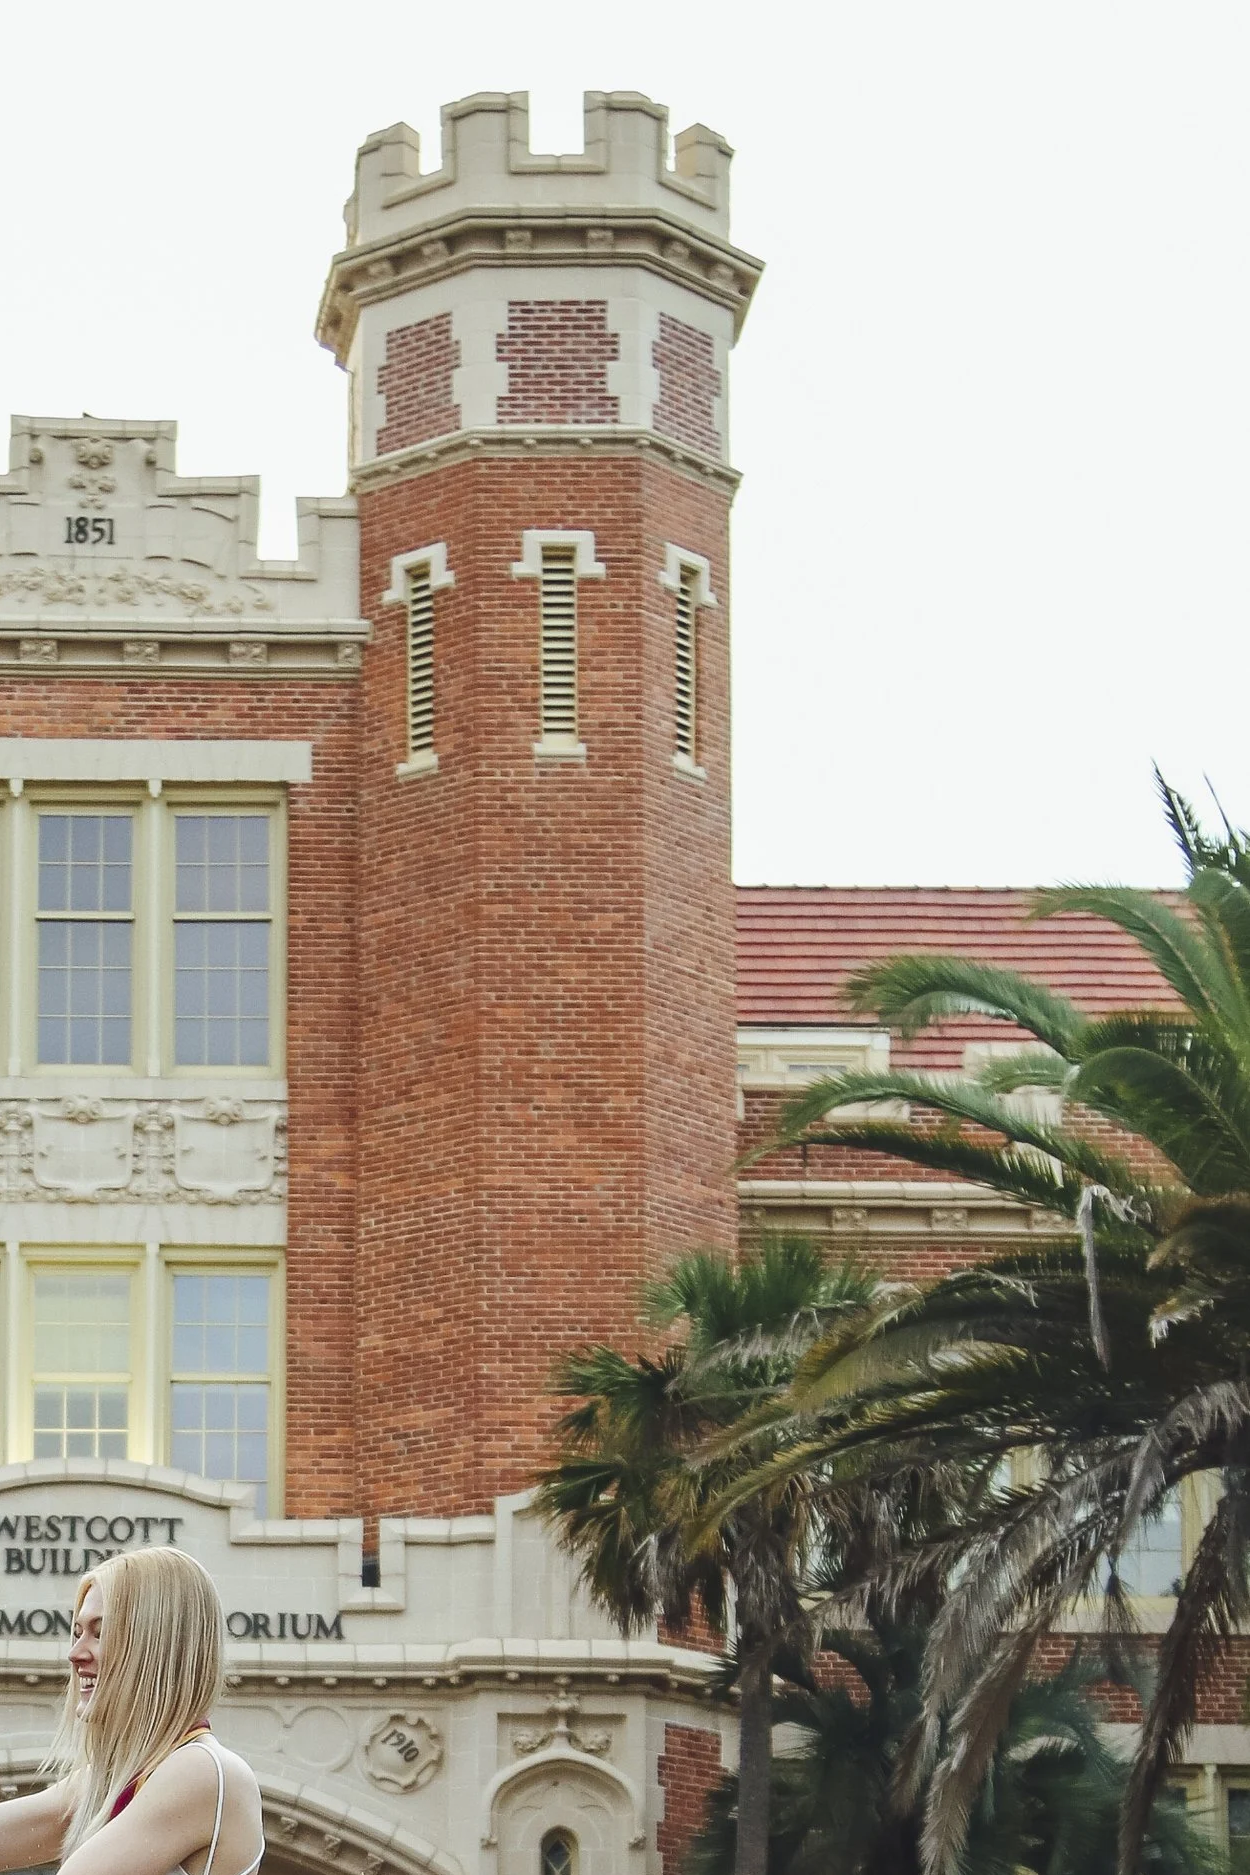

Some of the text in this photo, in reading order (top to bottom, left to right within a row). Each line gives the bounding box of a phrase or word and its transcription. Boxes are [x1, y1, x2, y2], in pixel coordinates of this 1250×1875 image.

[64, 516, 115, 545] 1851
[4, 1547, 124, 1575] BUILD
[226, 1611, 345, 1640] ORIUM
[380, 1729, 419, 1763] 1910
